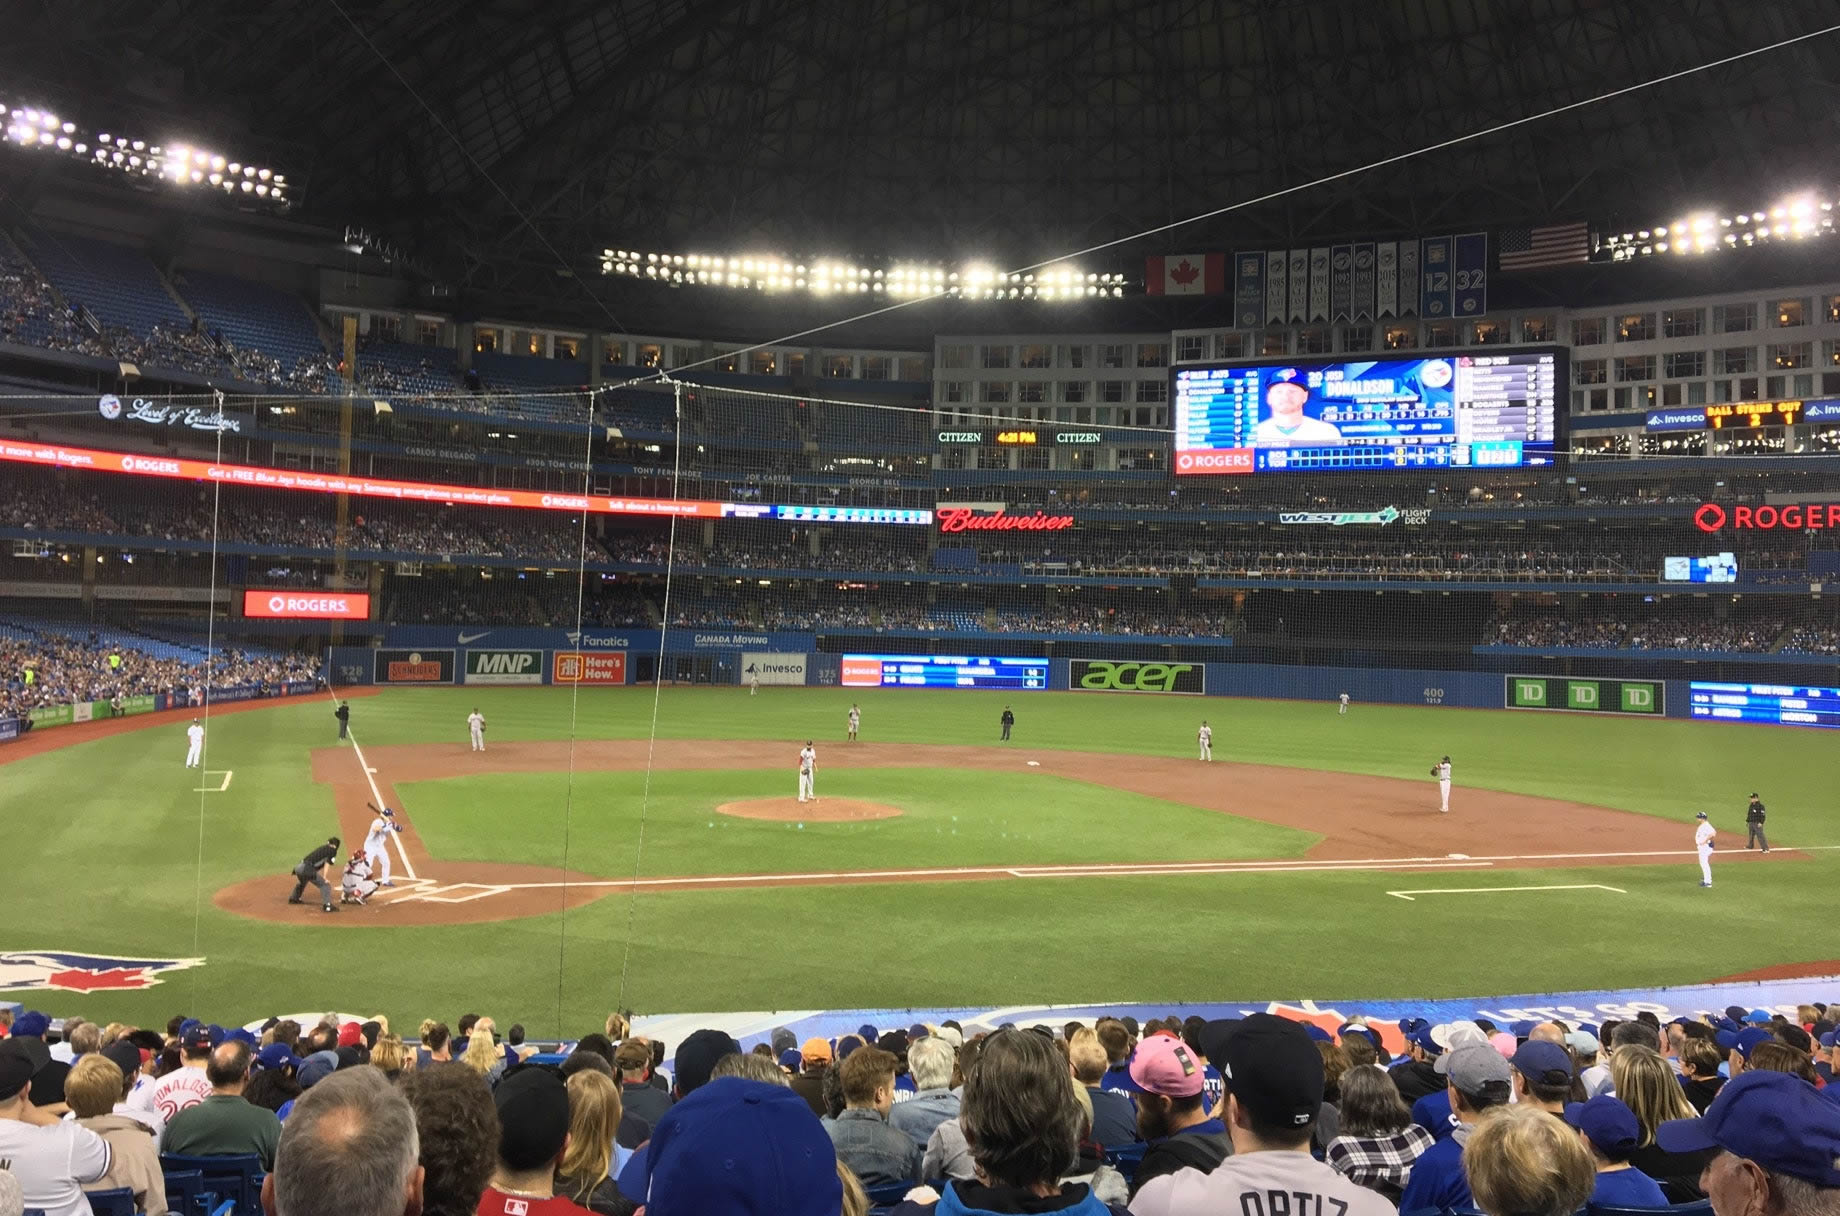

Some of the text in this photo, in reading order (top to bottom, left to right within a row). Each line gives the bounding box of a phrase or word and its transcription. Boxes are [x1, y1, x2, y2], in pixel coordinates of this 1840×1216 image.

[1425, 272, 1448, 292] 12
[1456, 269, 1485, 290] 32
[1474, 357, 1509, 366] RED SOX
[1325, 371, 1344, 381] JOSH
[1327, 379, 1395, 397] DONALDSON
[126, 398, 240, 432] Level of Excellence
[1707, 401, 1801, 417] BALL STRIKE OUT
[1665, 414, 1705, 424] Invesco
[1713, 412, 1793, 429] 1 2 1
[938, 432, 981, 442] CITIZEN
[1020, 432, 1037, 443] PM
[1057, 432, 1101, 443] CITIZEN
[6, 448, 33, 457] more
[34, 450, 57, 460] with
[58, 452, 94, 466] Rogers.
[405, 447, 476, 461] CARLOS DELGADO
[135, 459, 179, 473] ROGERS
[548, 460, 566, 469] TOM
[1195, 455, 1250, 467] ROGERS
[632, 466, 702, 478] TONY FERNANDEZ
[745, 473, 792, 483] JOE CARTER
[207, 467, 225, 478] Get
[233, 470, 254, 481] FREE
[255, 473, 276, 483] Blue
[276, 475, 295, 488] Jays
[296, 476, 326, 488] hoodie
[328, 479, 347, 490] with
[347, 481, 362, 493] any
[364, 483, 402, 497] Samsung
[403, 487, 451, 499] smartphone
[452, 491, 463, 499] on
[464, 491, 487, 501] select
[849, 478, 880, 486] GEORGE
[552, 497, 589, 508] ROGERS
[609, 501, 625, 510] Talk
[625, 502, 650, 511] about
[656, 503, 680, 512] home
[1401, 509, 1431, 517] FLIGHT
[937, 507, 1074, 532] Budweiser
[1405, 517, 1427, 525] DECK
[288, 599, 347, 612] ROGERS
[583, 635, 629, 647] Fanatics
[694, 634, 768, 645] CANADA MOVING
[476, 654, 533, 673] MNP
[585, 656, 621, 668] Here's
[585, 668, 613, 679] How.
[763, 663, 803, 674] Invesco
[818, 670, 836, 678] 375
[851, 667, 879, 675] ROGERS
[1081, 662, 1192, 691] acer
[1423, 688, 1444, 698] 400
[1519, 684, 1544, 701] TD
[1571, 686, 1596, 703] TD
[1626, 688, 1650, 706] TD
[1596, 1002, 1670, 1019] GO
[153, 1079, 213, 1108] DONALDSO
[1239, 1189, 1349, 1216] ORTIZ
